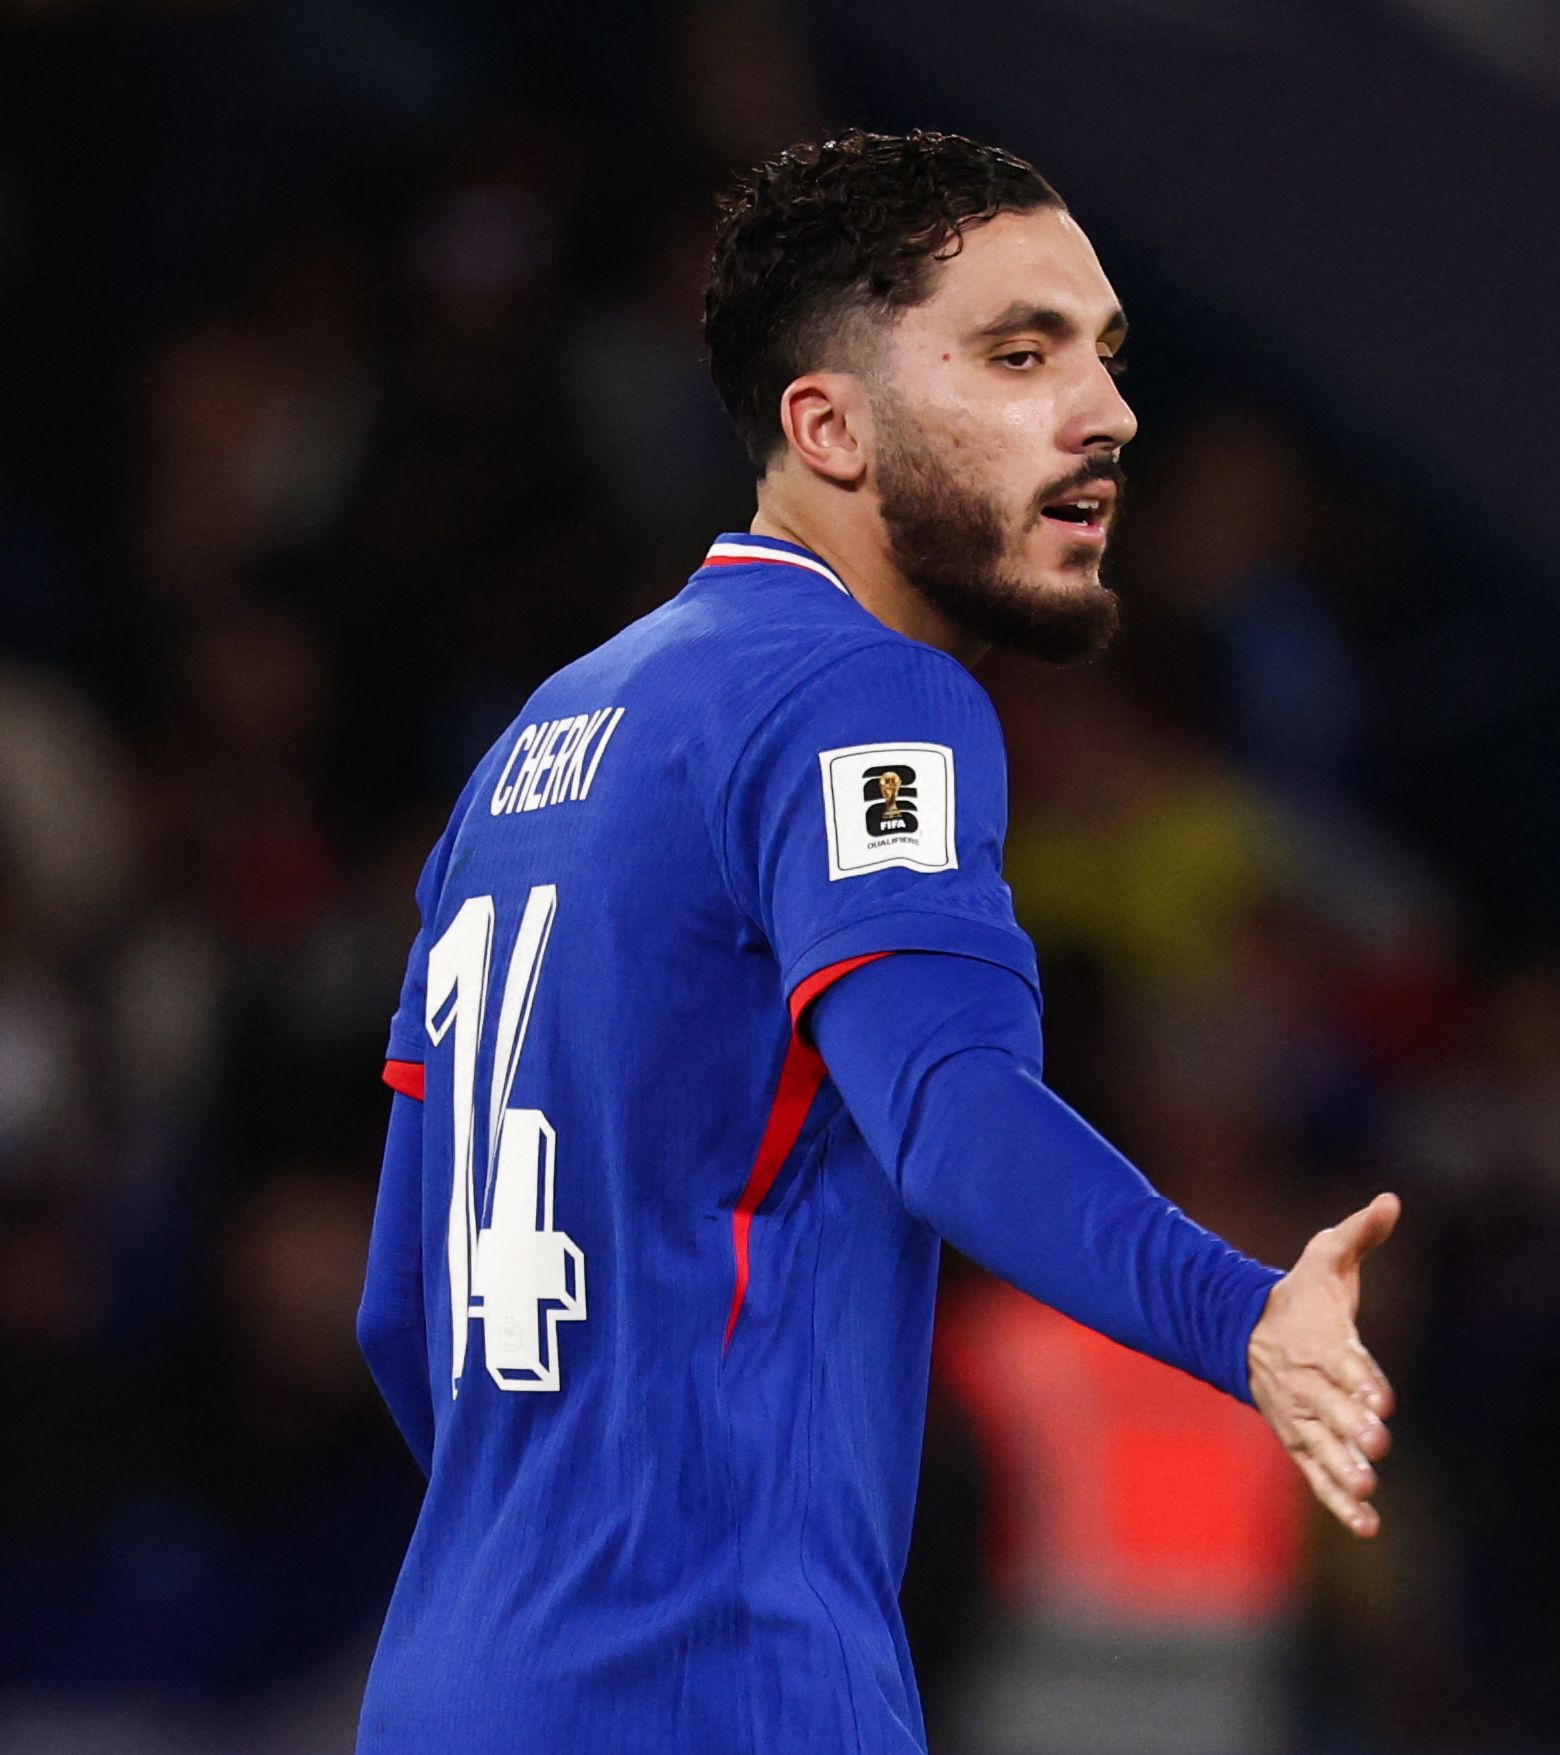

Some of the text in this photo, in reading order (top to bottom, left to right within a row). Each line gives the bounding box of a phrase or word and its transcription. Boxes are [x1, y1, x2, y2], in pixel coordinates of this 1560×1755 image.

[490, 707, 625, 817] CHERKI
[866, 836, 920, 849] QUALIFIERS
[880, 819, 907, 831] FIFA
[425, 884, 587, 1400] 14
